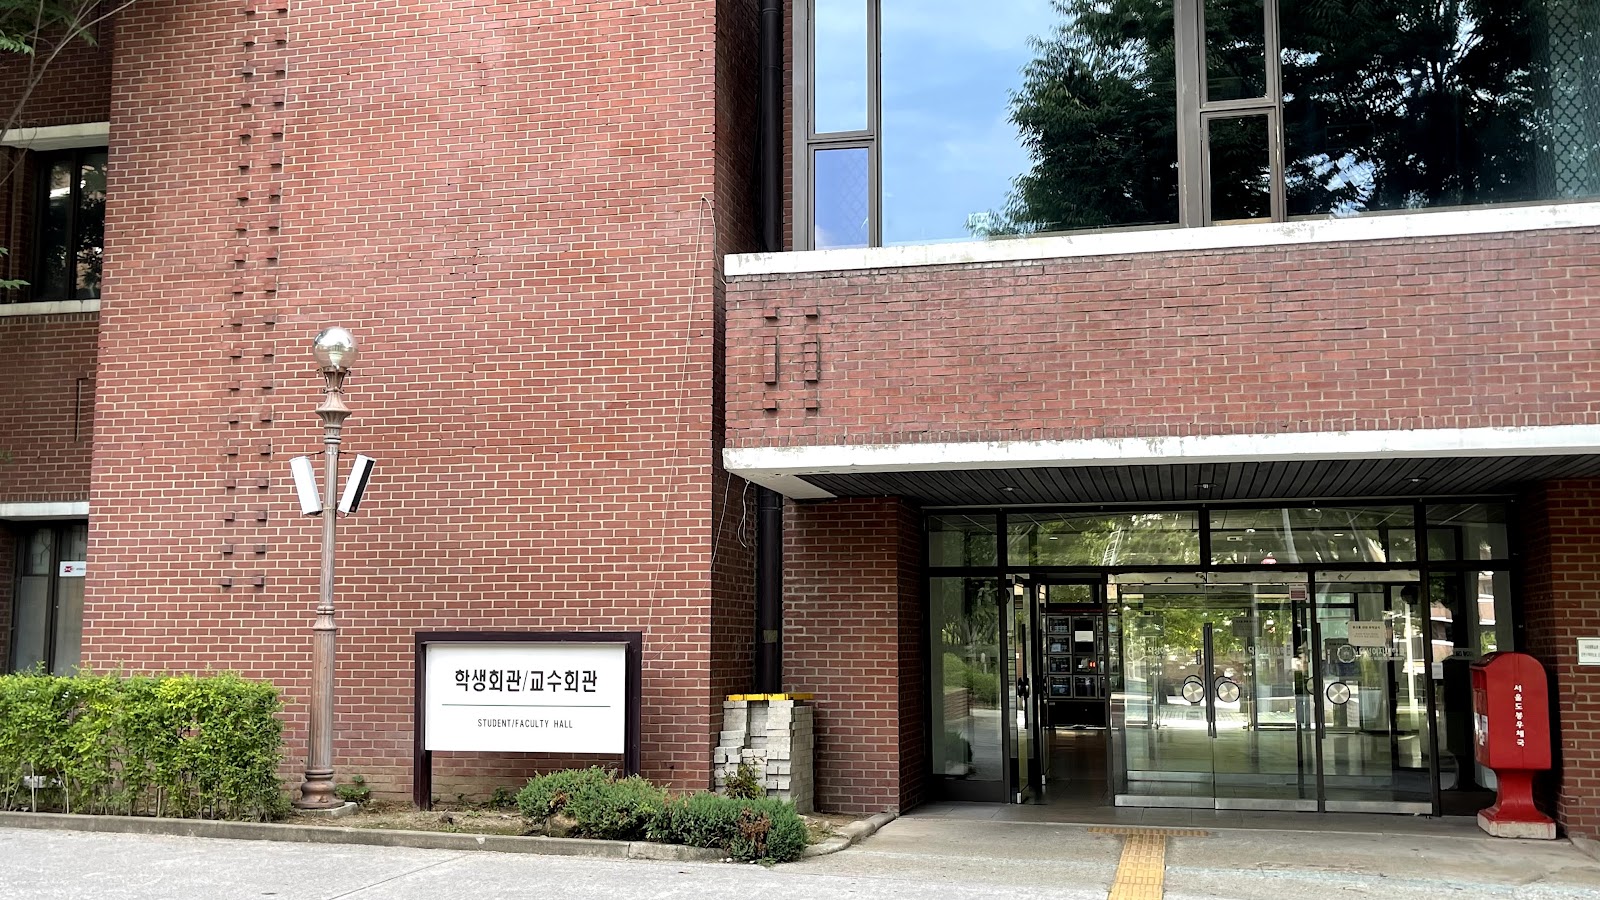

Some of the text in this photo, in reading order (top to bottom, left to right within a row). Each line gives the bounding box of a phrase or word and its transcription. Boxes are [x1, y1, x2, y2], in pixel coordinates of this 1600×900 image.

[455, 669, 598, 693] 학생회관/교수회관
[477, 718, 573, 729] STUDENT/FACULTY HALL
[1513, 684, 1525, 747] 서울도봉우체국
